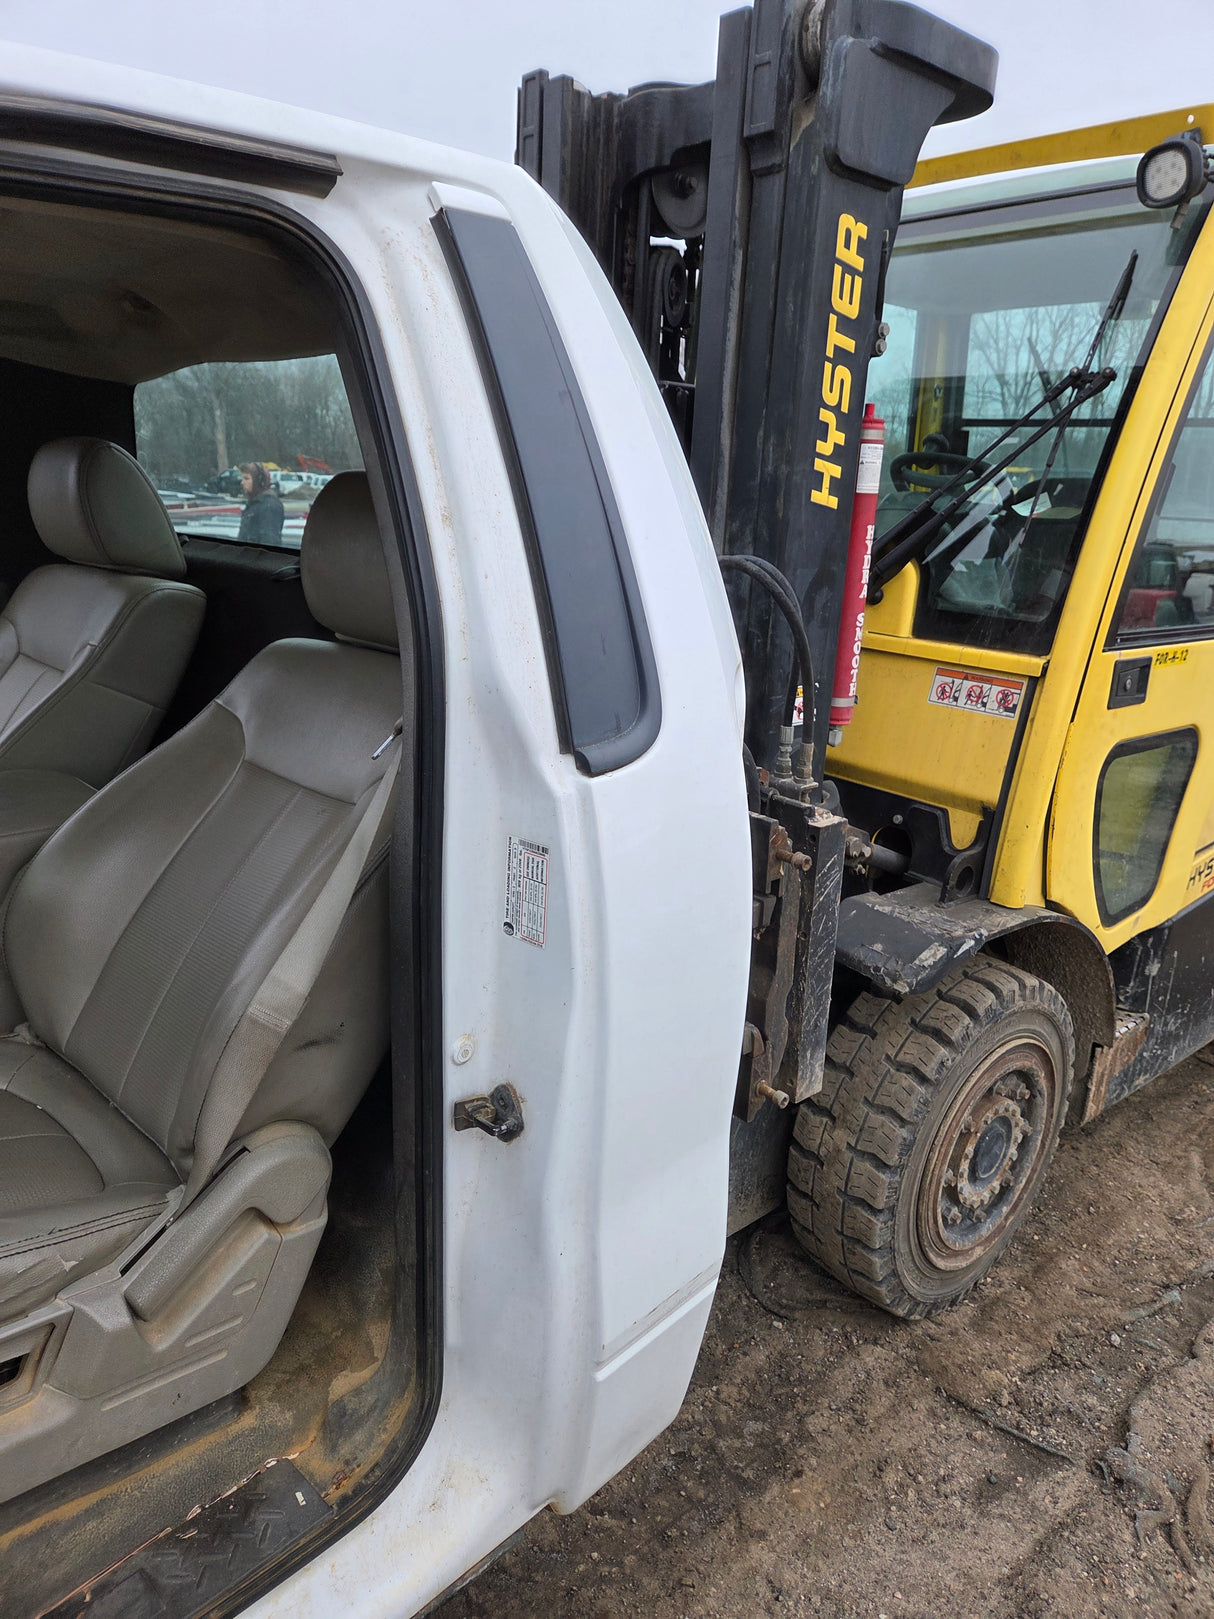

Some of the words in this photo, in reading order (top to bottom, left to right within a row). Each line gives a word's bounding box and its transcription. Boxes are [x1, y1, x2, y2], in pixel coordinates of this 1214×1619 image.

[810, 213, 868, 510] HYSTER
[859, 524, 875, 599] HYDRA
[848, 612, 865, 697] SMOOTH
